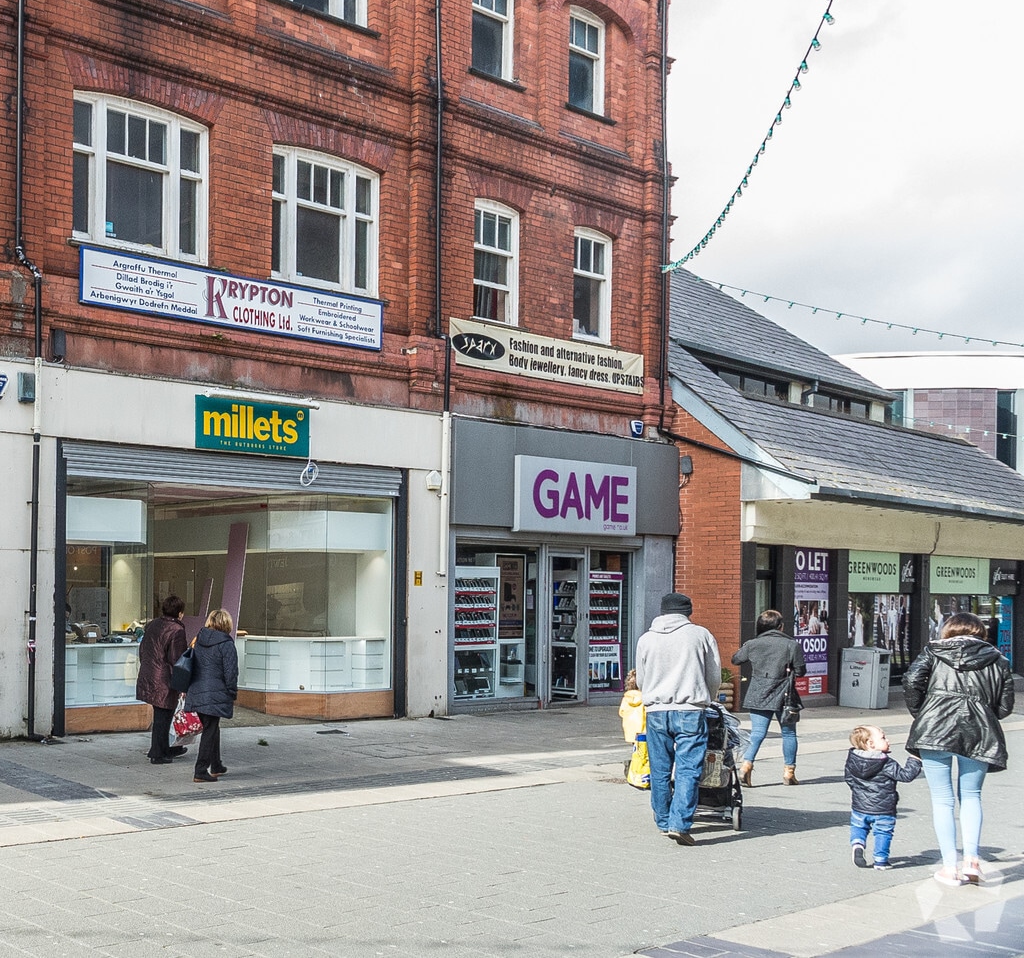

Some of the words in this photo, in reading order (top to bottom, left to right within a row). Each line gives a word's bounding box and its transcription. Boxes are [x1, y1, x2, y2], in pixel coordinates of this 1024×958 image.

[113, 260, 145, 272] Argraffu
[116, 273, 138, 282] Dillad
[141, 277, 165, 289] Brodig
[115, 283, 143, 293] Gwaith
[156, 289, 174, 299] Ysgol
[202, 275, 293, 319] KRYPTON
[90, 291, 137, 305] Arbenigwyr
[171, 304, 198, 314] Meddal
[340, 303, 362, 314] Printing
[233, 306, 275, 328] CLOTHING
[279, 314, 293, 331] Ltd.
[299, 314, 331, 326] Workwear
[339, 321, 374, 332] Schoolwear
[318, 309, 356, 321] Embroidered
[312, 328, 343, 339] Furnishing
[345, 333, 375, 343] Specialists
[510, 338, 538, 354] Fashion
[541, 346, 554, 357] and
[557, 348, 595, 364] alternative
[509, 354, 528, 370] Body
[568, 365, 588, 380] fancy
[612, 373, 644, 387] UPSTAIRS
[203, 404, 298, 444] millets
[533, 469, 629, 523] GAME
[795, 552, 806, 571] O
[808, 552, 828, 572] LET
[848, 562, 896, 576] GREENWOODS
[936, 566, 976, 578] GREENWOODS
[803, 638, 827, 653] OSOD
